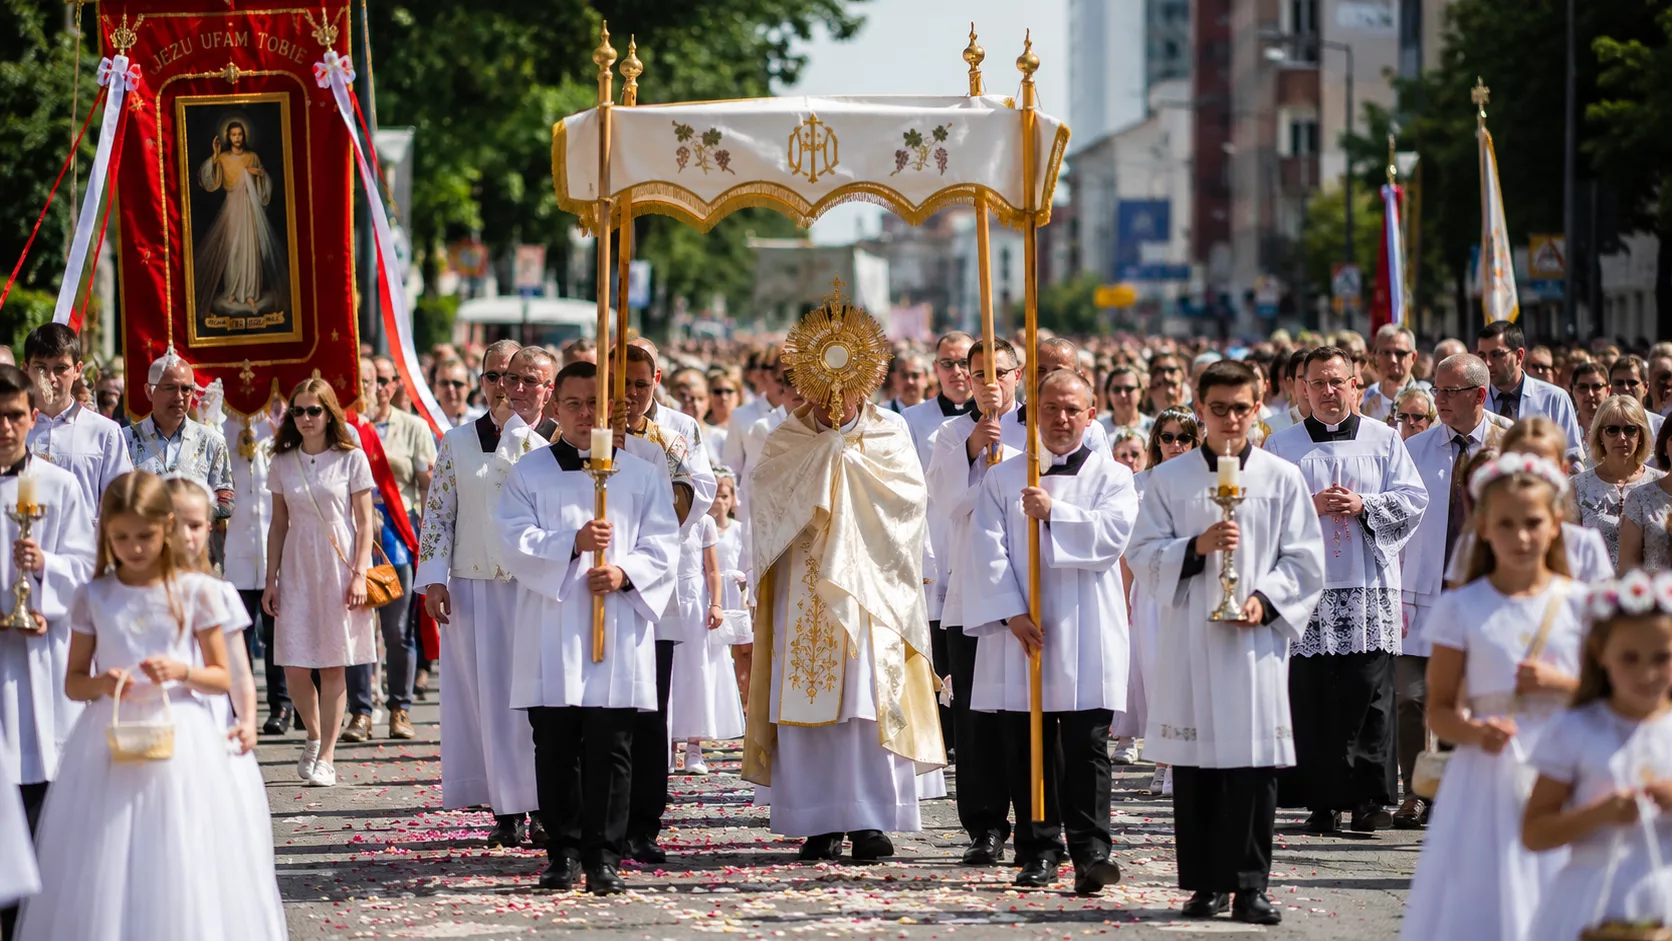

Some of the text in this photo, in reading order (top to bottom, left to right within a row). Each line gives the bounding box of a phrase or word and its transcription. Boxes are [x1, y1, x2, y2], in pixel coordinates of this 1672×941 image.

[149, 31, 307, 75] JEZU UFAM TOBIE
